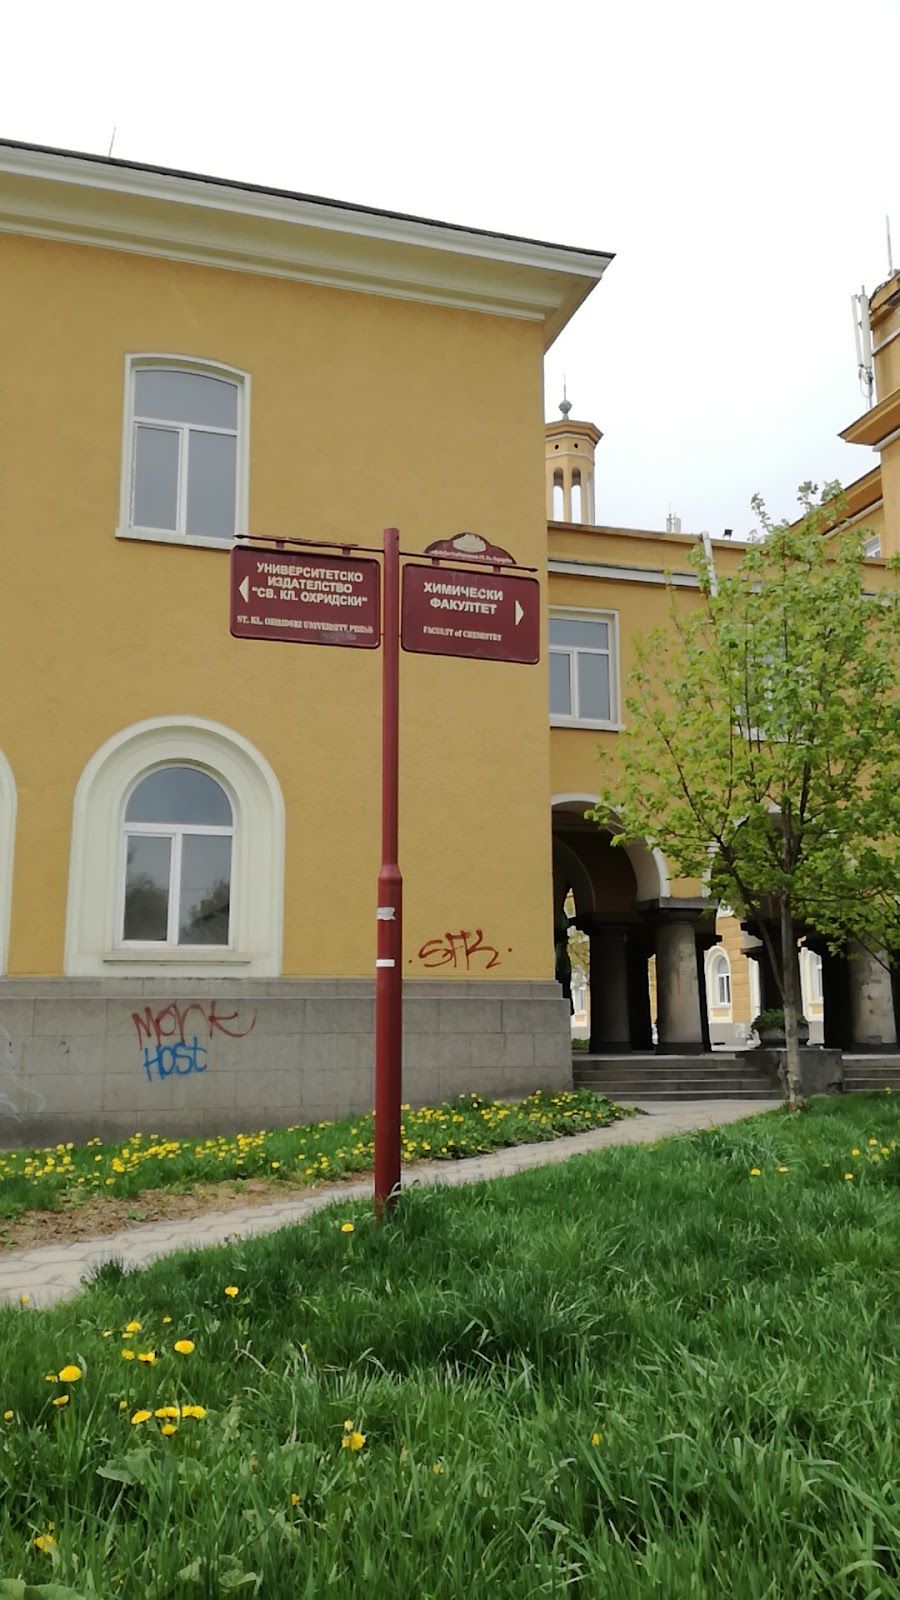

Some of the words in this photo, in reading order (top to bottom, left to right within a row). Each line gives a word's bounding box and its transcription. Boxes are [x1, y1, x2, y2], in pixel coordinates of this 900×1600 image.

[256, 562, 363, 583] УНИВЕРСИТЕТСКО
[267, 576, 353, 593] ИЗДАТЕЛСТВО
[423, 582, 503, 600] ХИМИЧЕСКИ
[280, 589, 298, 601] КЛ.
[429, 597, 498, 615] ФАКУЛТЕТ
[423, 626, 454, 637] FACULTY
[454, 629, 462, 638] of
[463, 630, 502, 642] CHEMISTRY
